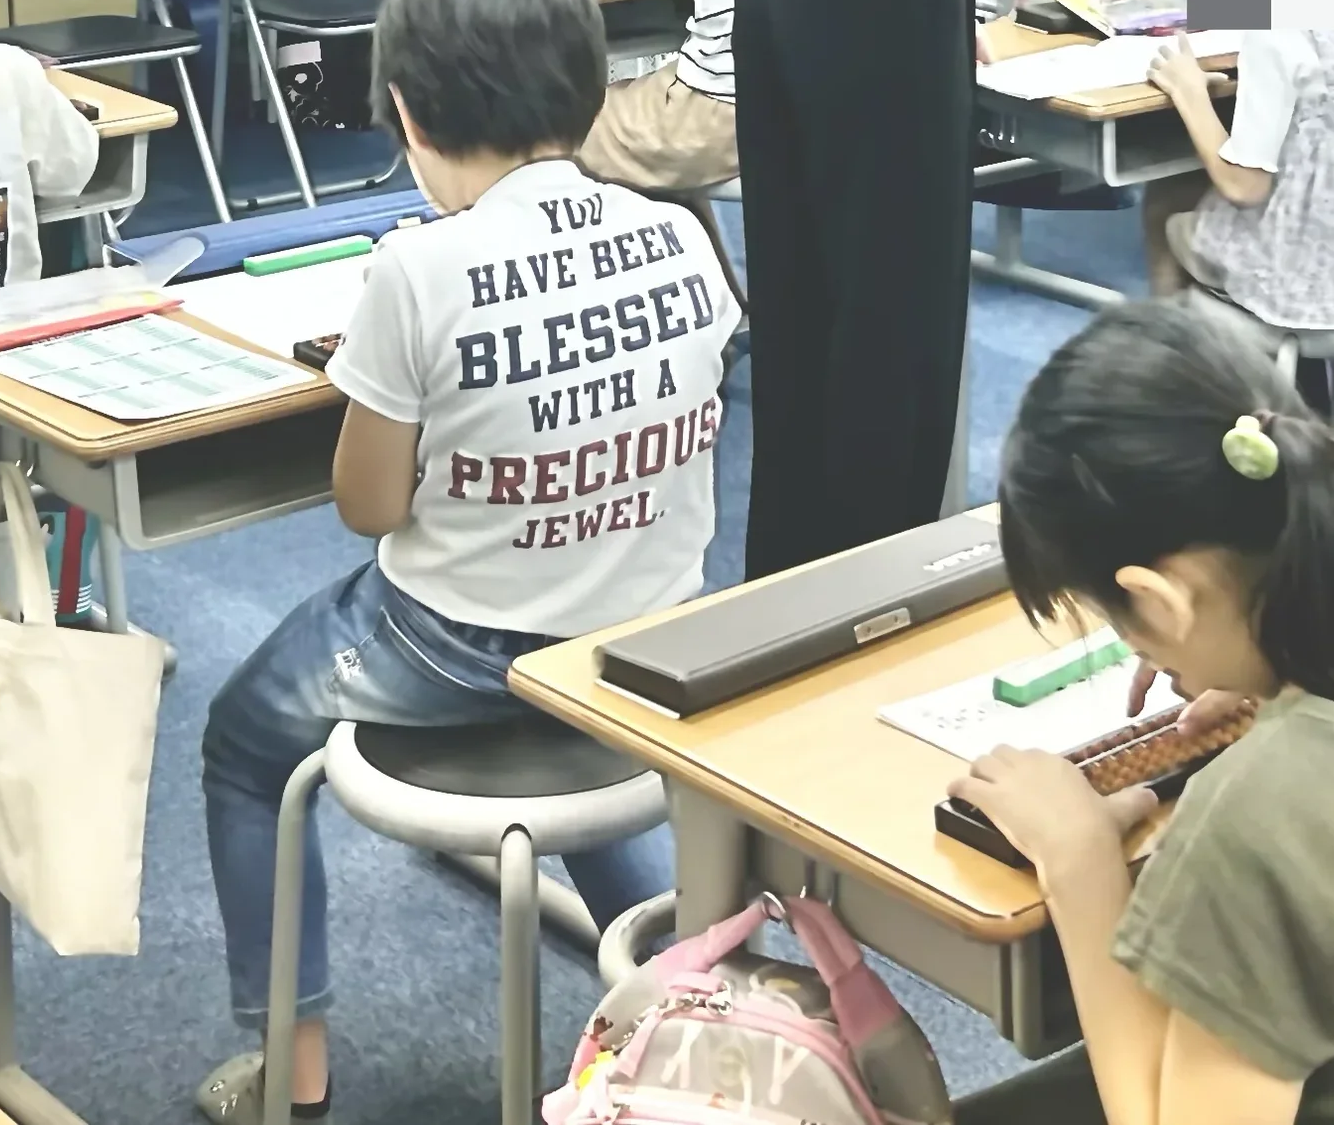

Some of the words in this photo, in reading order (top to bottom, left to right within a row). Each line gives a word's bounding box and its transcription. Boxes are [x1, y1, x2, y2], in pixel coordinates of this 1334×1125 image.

[539, 193, 602, 234] YOU
[467, 247, 576, 308] HAVE
[590, 220, 685, 280] BEEN
[456, 273, 714, 390] BLESSED
[528, 369, 637, 432] WITH
[657, 358, 677, 399] A
[448, 396, 718, 505] PRECIOUS
